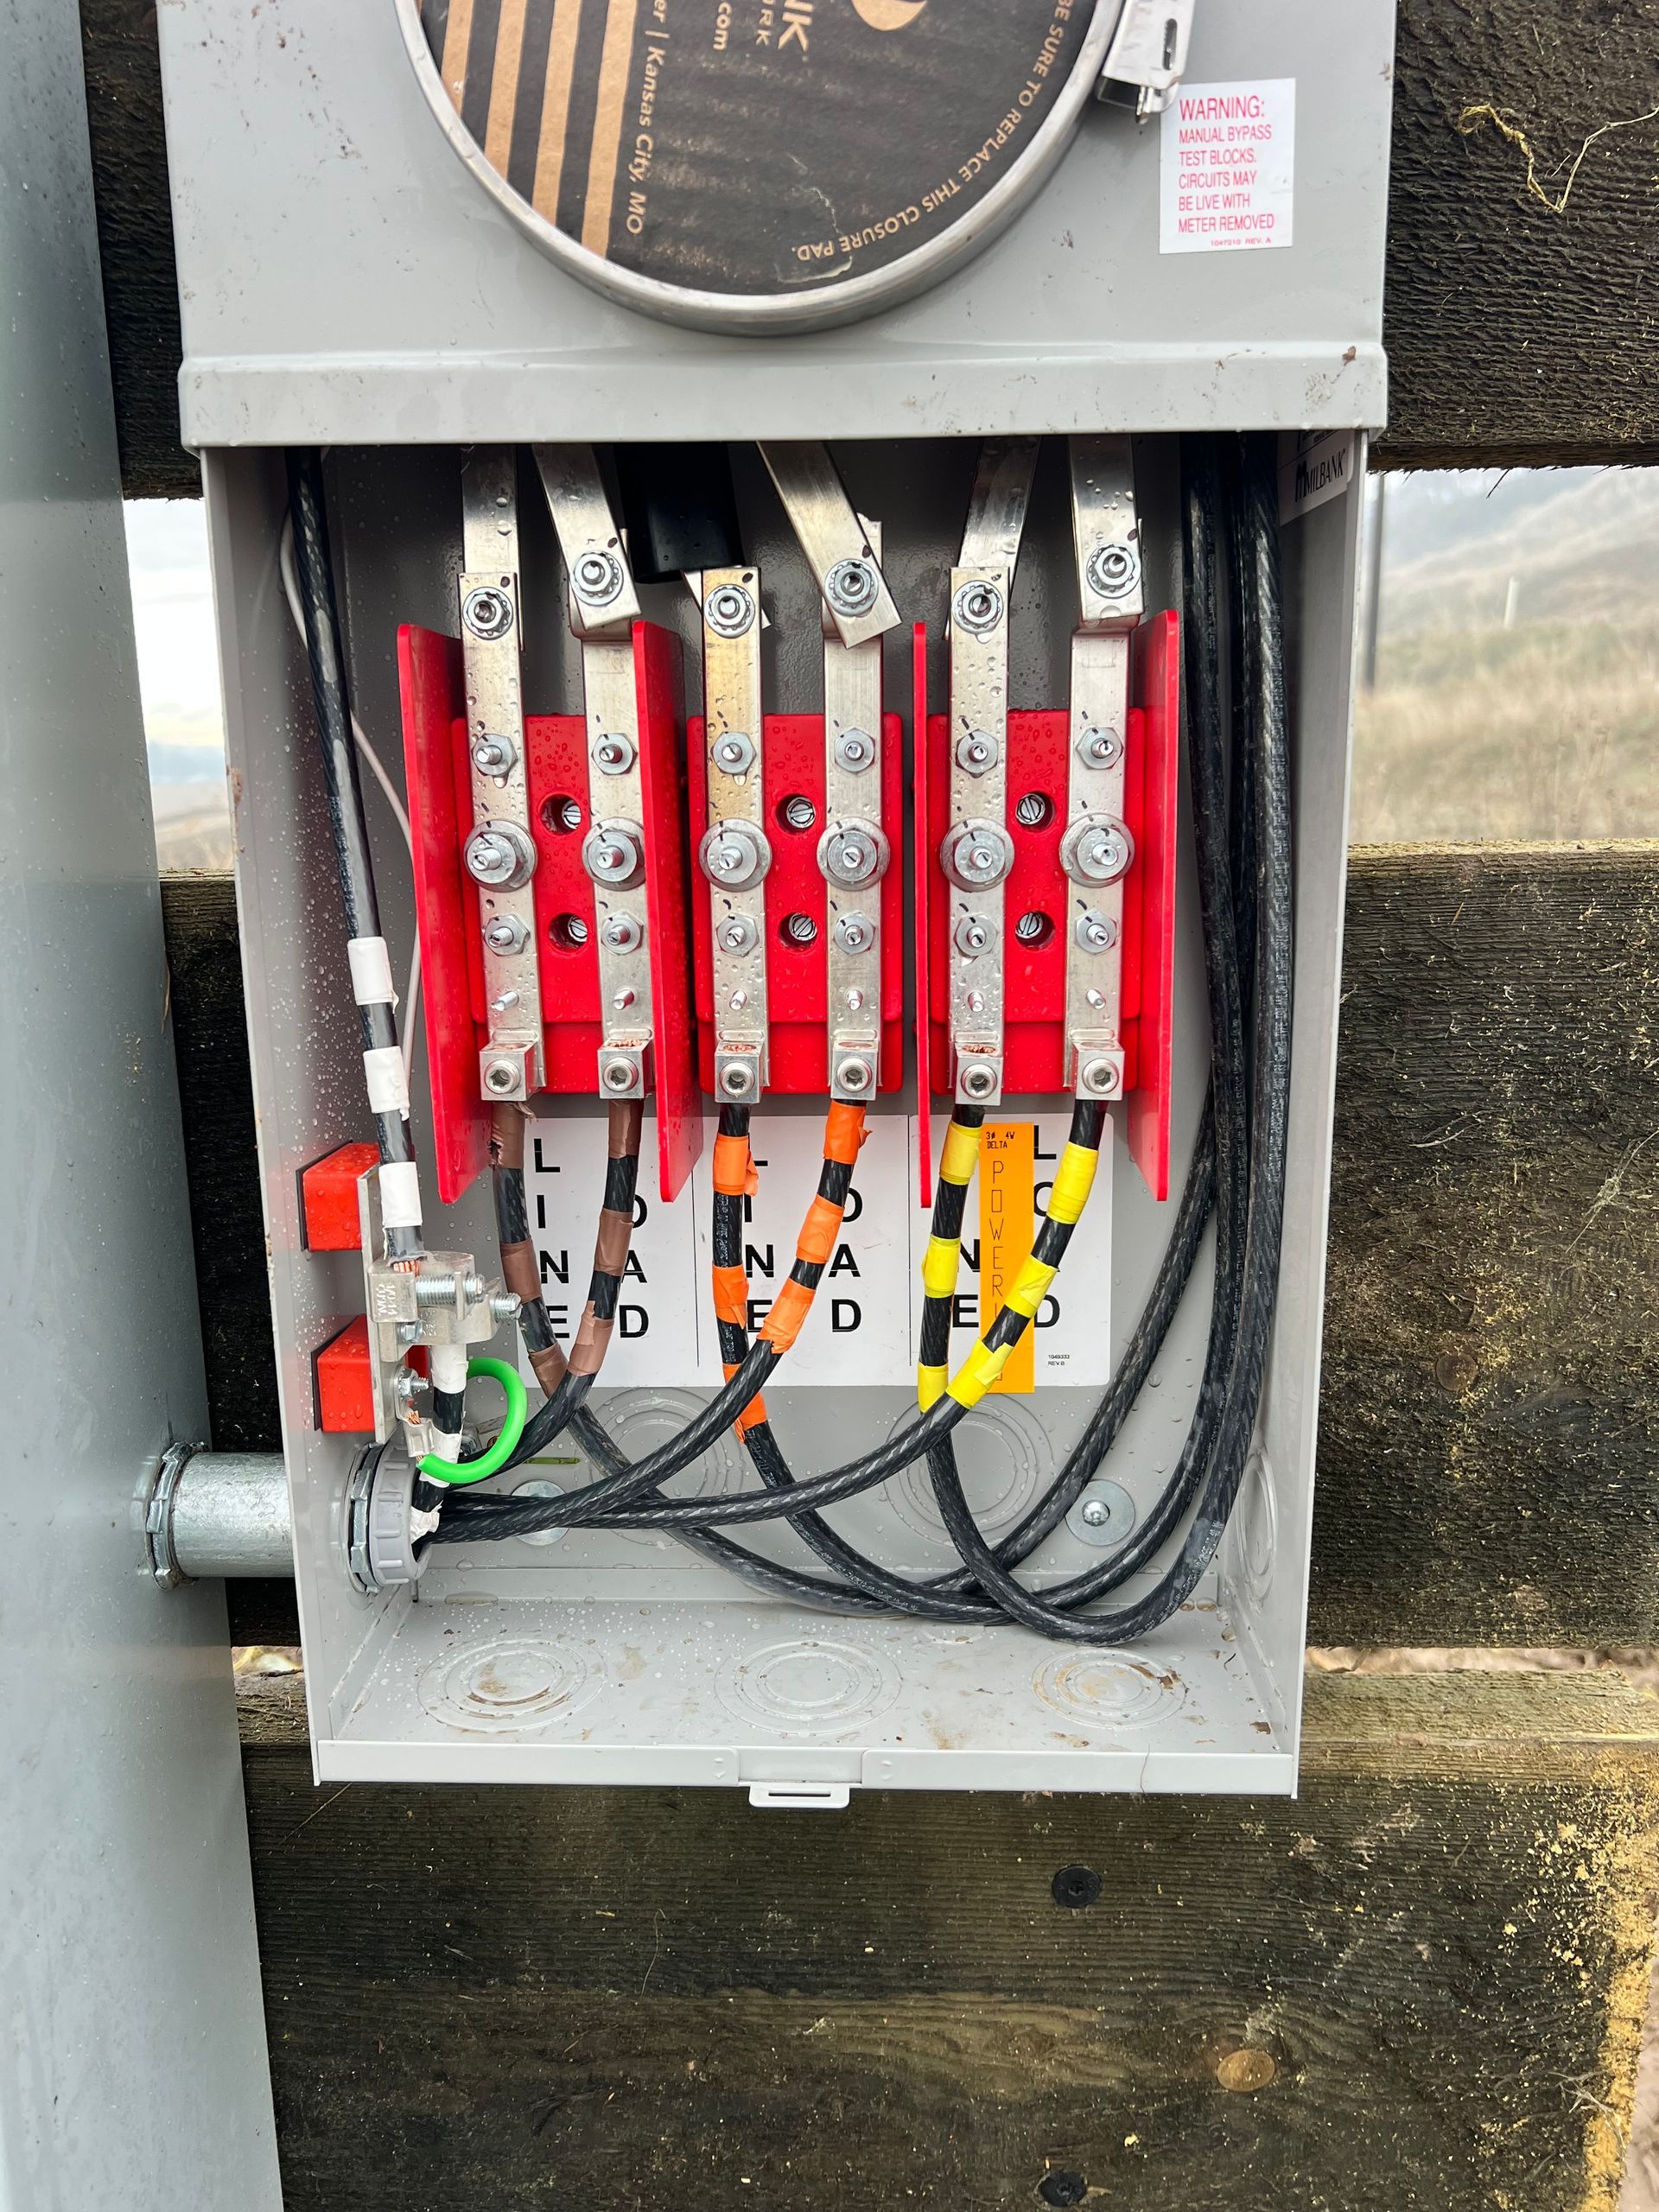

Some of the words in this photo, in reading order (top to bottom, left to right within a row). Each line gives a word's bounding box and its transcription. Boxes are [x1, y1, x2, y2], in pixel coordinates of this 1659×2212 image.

[1033, 23, 1065, 77] SURE
[639, 46, 666, 127] Kansas
[1018, 79, 1041, 107] TO
[1179, 95, 1265, 121] WARNING:
[957, 109, 1021, 182] REPLACE
[1179, 127, 1224, 144] MANUAL
[1228, 124, 1272, 142] BYPASS
[628, 133, 654, 182] City,
[1179, 150, 1207, 166] TEST
[1210, 148, 1257, 165] BLOCKS.
[1179, 172, 1230, 189] CIRCUITS
[1233, 170, 1258, 186] MAY
[922, 178, 961, 213] THIS
[1179, 196, 1192, 211] BE
[1196, 194, 1219, 210] LIVE
[1222, 193, 1250, 208] WITH
[626, 191, 646, 235] MO
[1179, 217, 1216, 233] METER
[1219, 213, 1274, 232] REMOVED
[840, 207, 921, 252] CLOSURE
[791, 244, 835, 262] PAD.
[1304, 450, 1344, 496] MILBANK
[987, 1141, 1007, 1149] DELTA
